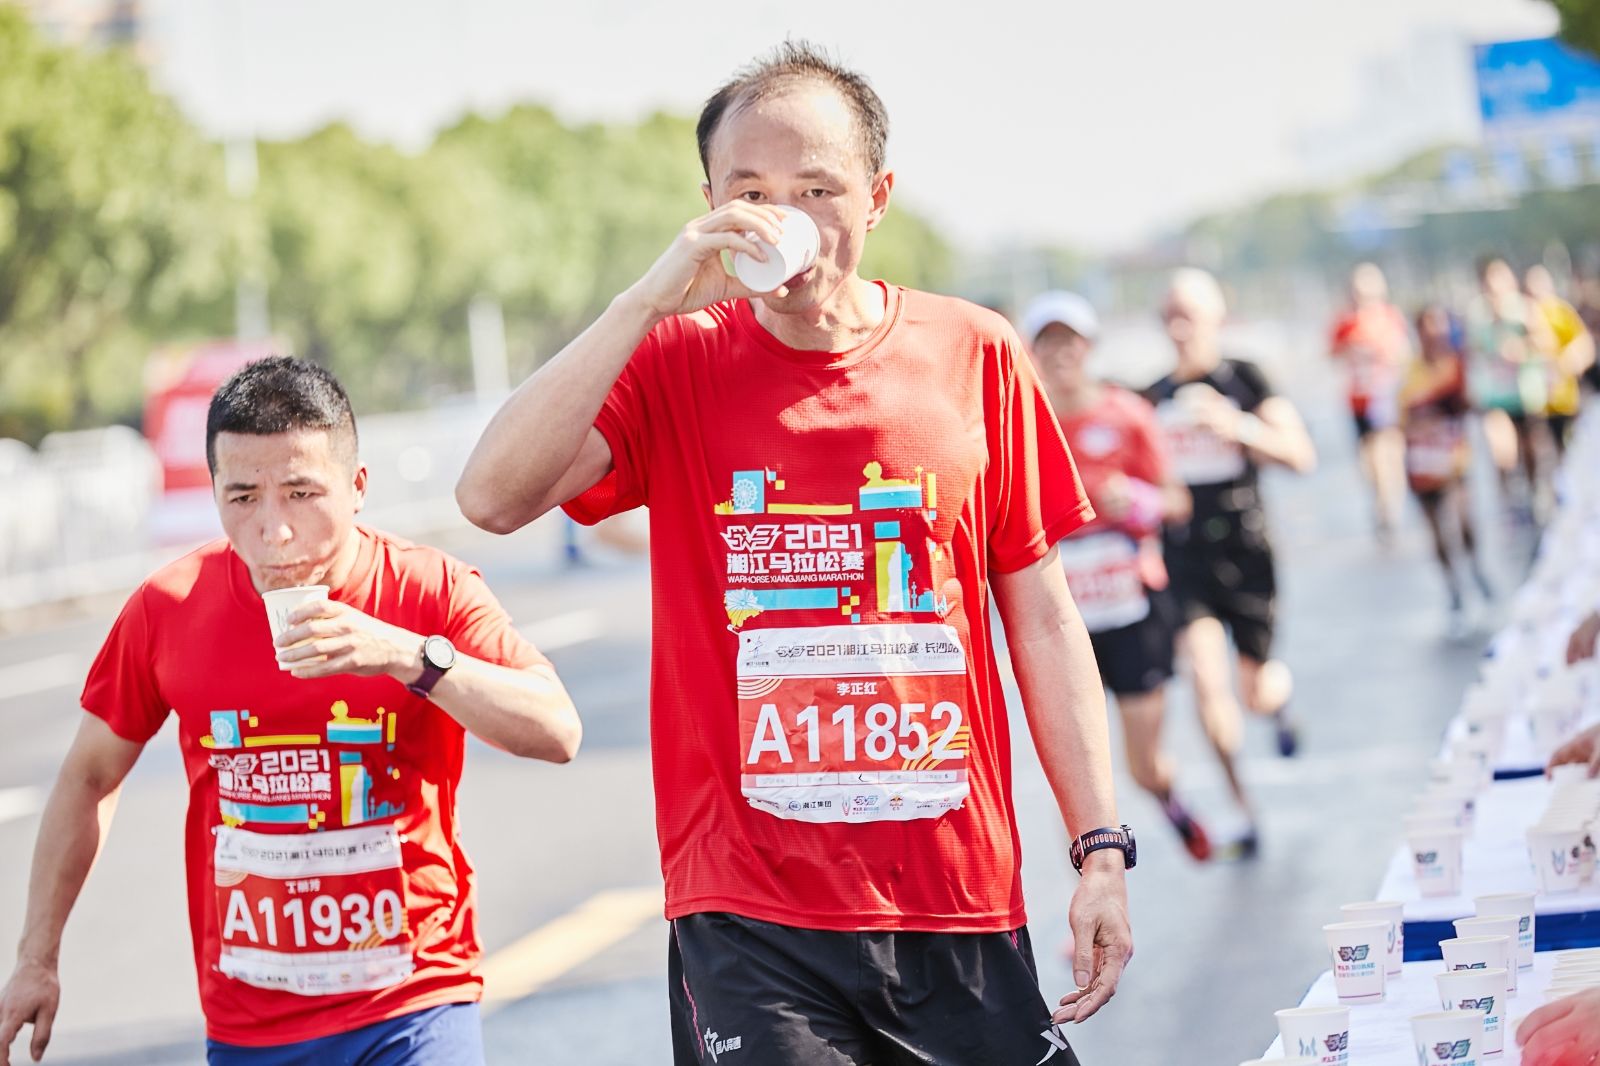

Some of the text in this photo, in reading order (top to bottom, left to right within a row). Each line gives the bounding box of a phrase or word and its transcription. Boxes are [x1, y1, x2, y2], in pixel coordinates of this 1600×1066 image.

[784, 524, 862, 549] 2021
[727, 551, 864, 574] 湘江马拉松赛
[727, 573, 864, 583] WARHORSE XIANGJIANG MARATHON
[837, 682, 878, 696] 李正红
[747, 701, 964, 764] A11852
[260, 749, 330, 773] 2021
[223, 889, 402, 947] A11930
